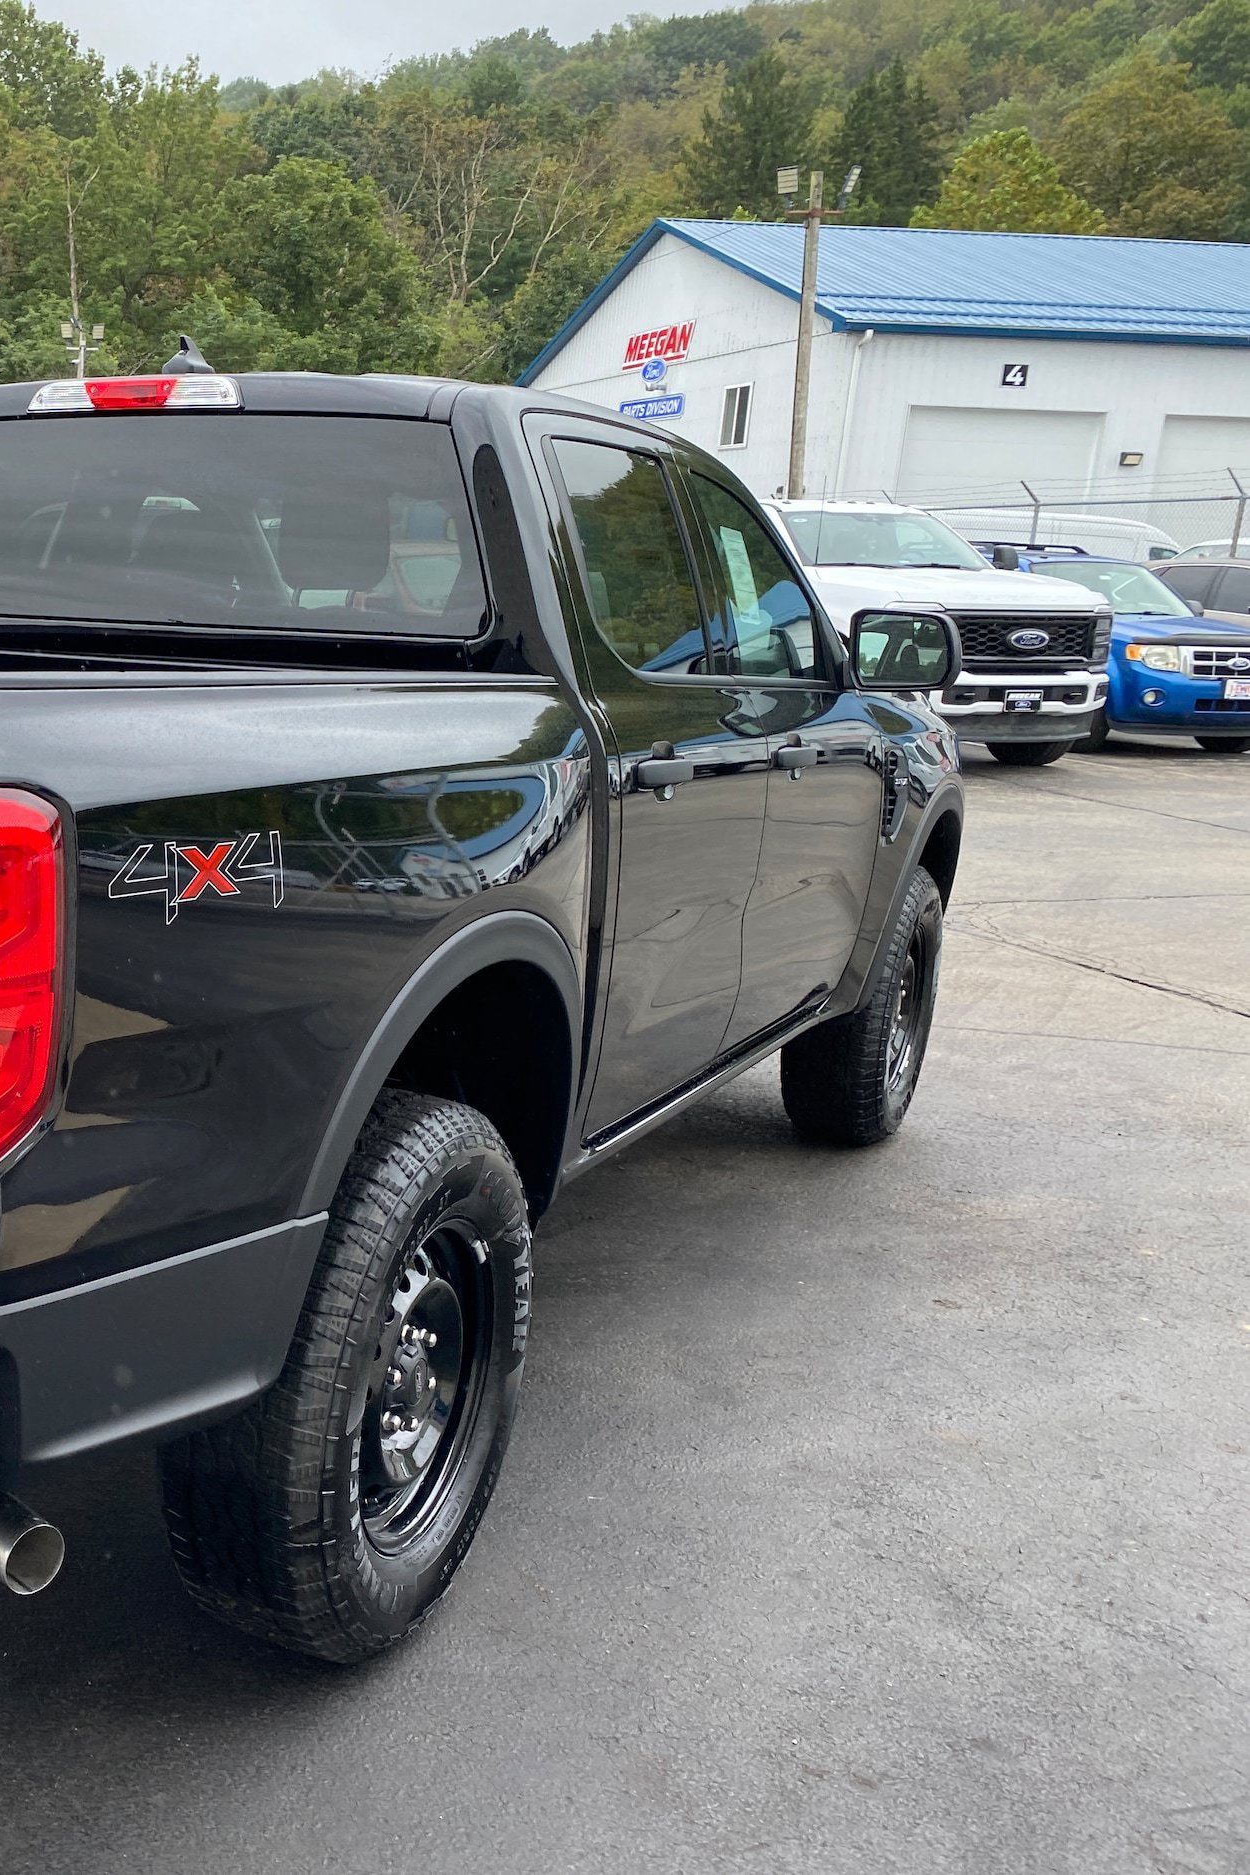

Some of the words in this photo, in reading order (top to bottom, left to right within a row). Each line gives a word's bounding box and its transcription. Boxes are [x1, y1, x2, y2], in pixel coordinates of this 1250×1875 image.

[623, 321, 694, 364] MEEGAN
[645, 361, 661, 379] Ford
[1005, 365, 1025, 386] 4
[623, 404, 646, 418] PARTS
[646, 399, 681, 416] DIVISION
[1019, 633, 1042, 645] Ford
